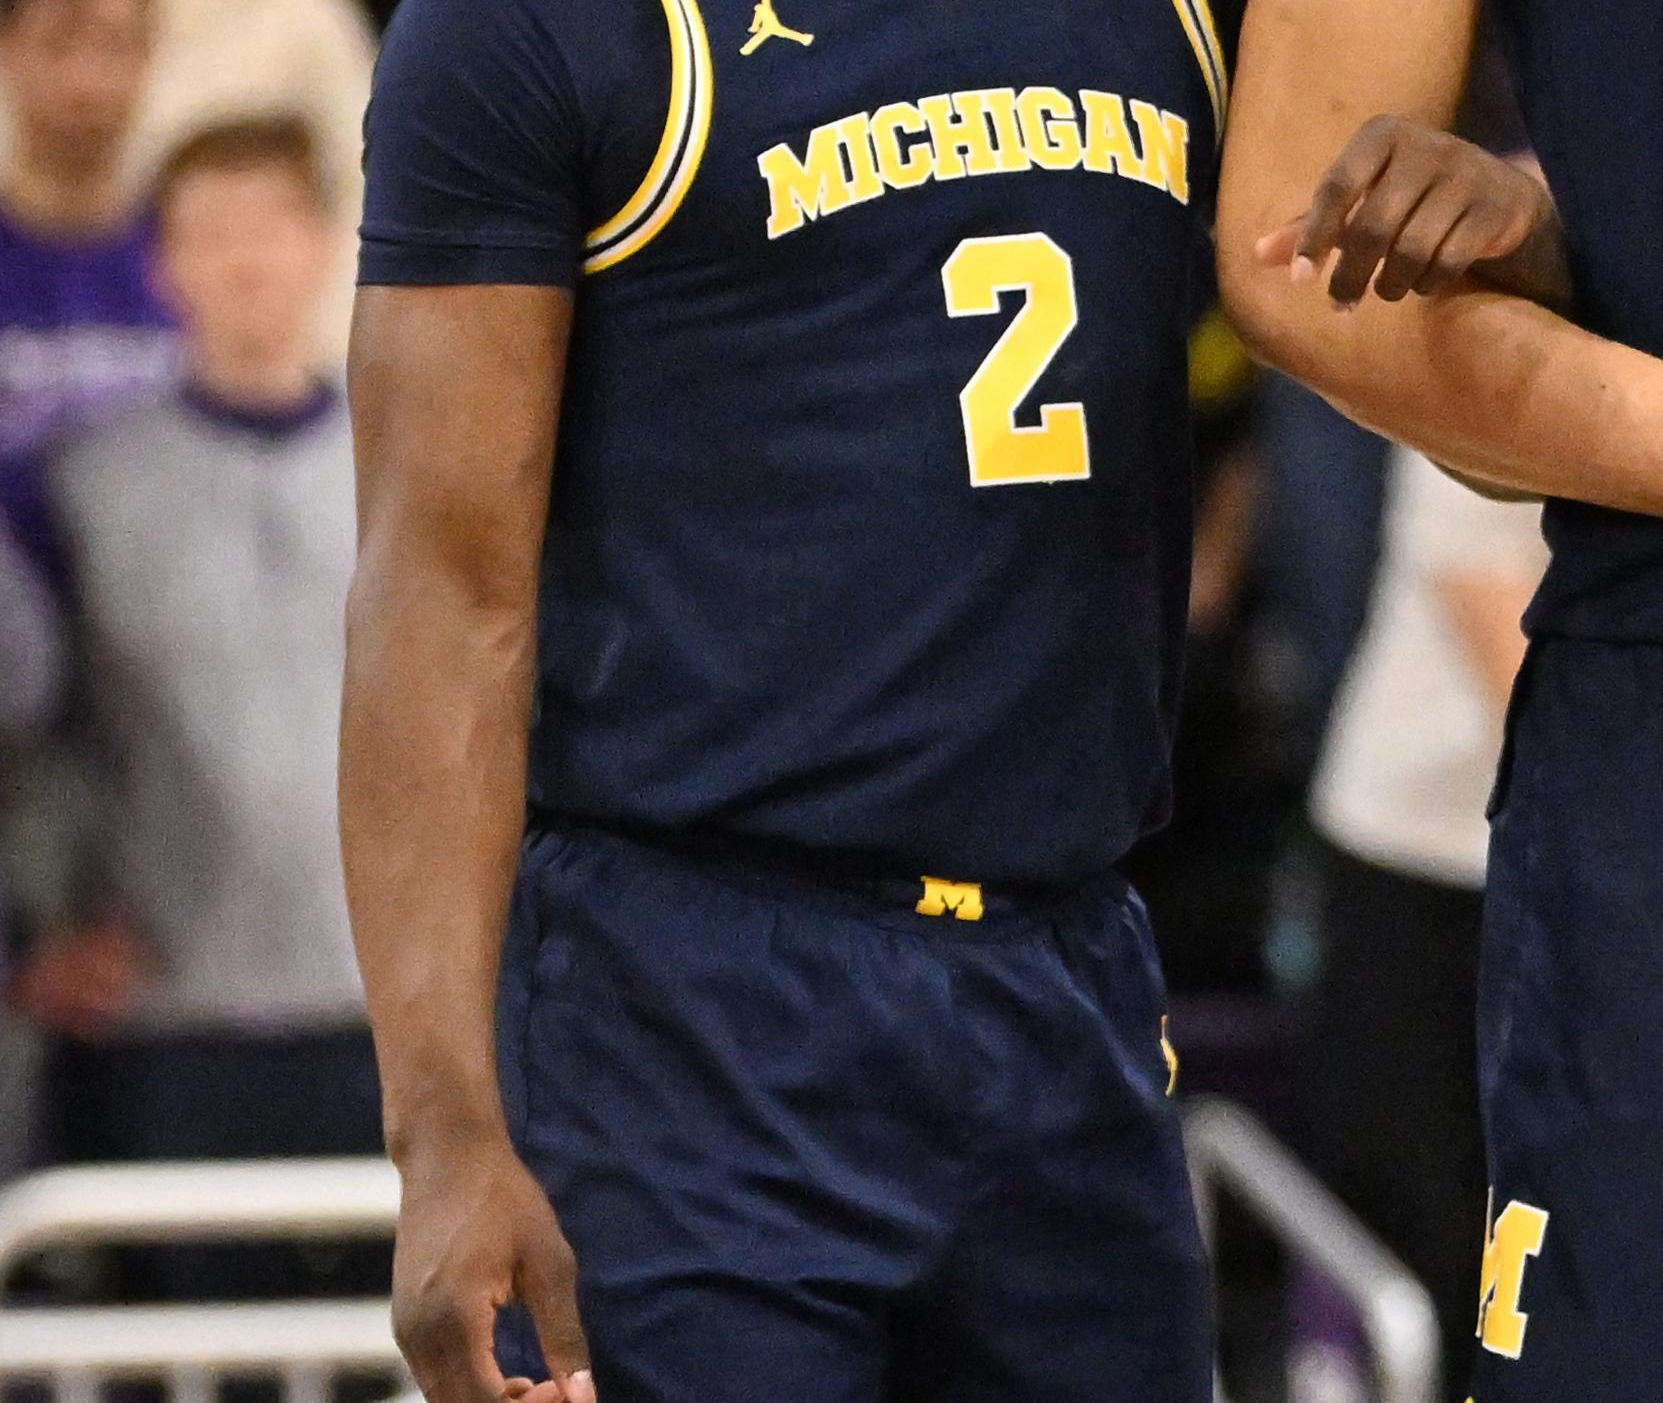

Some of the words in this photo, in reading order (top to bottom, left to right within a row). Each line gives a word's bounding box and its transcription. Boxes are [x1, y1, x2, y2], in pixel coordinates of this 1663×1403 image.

[757, 87, 1189, 239] MICHIGAN
[941, 231, 1091, 488] 2
[914, 875, 985, 921] M
